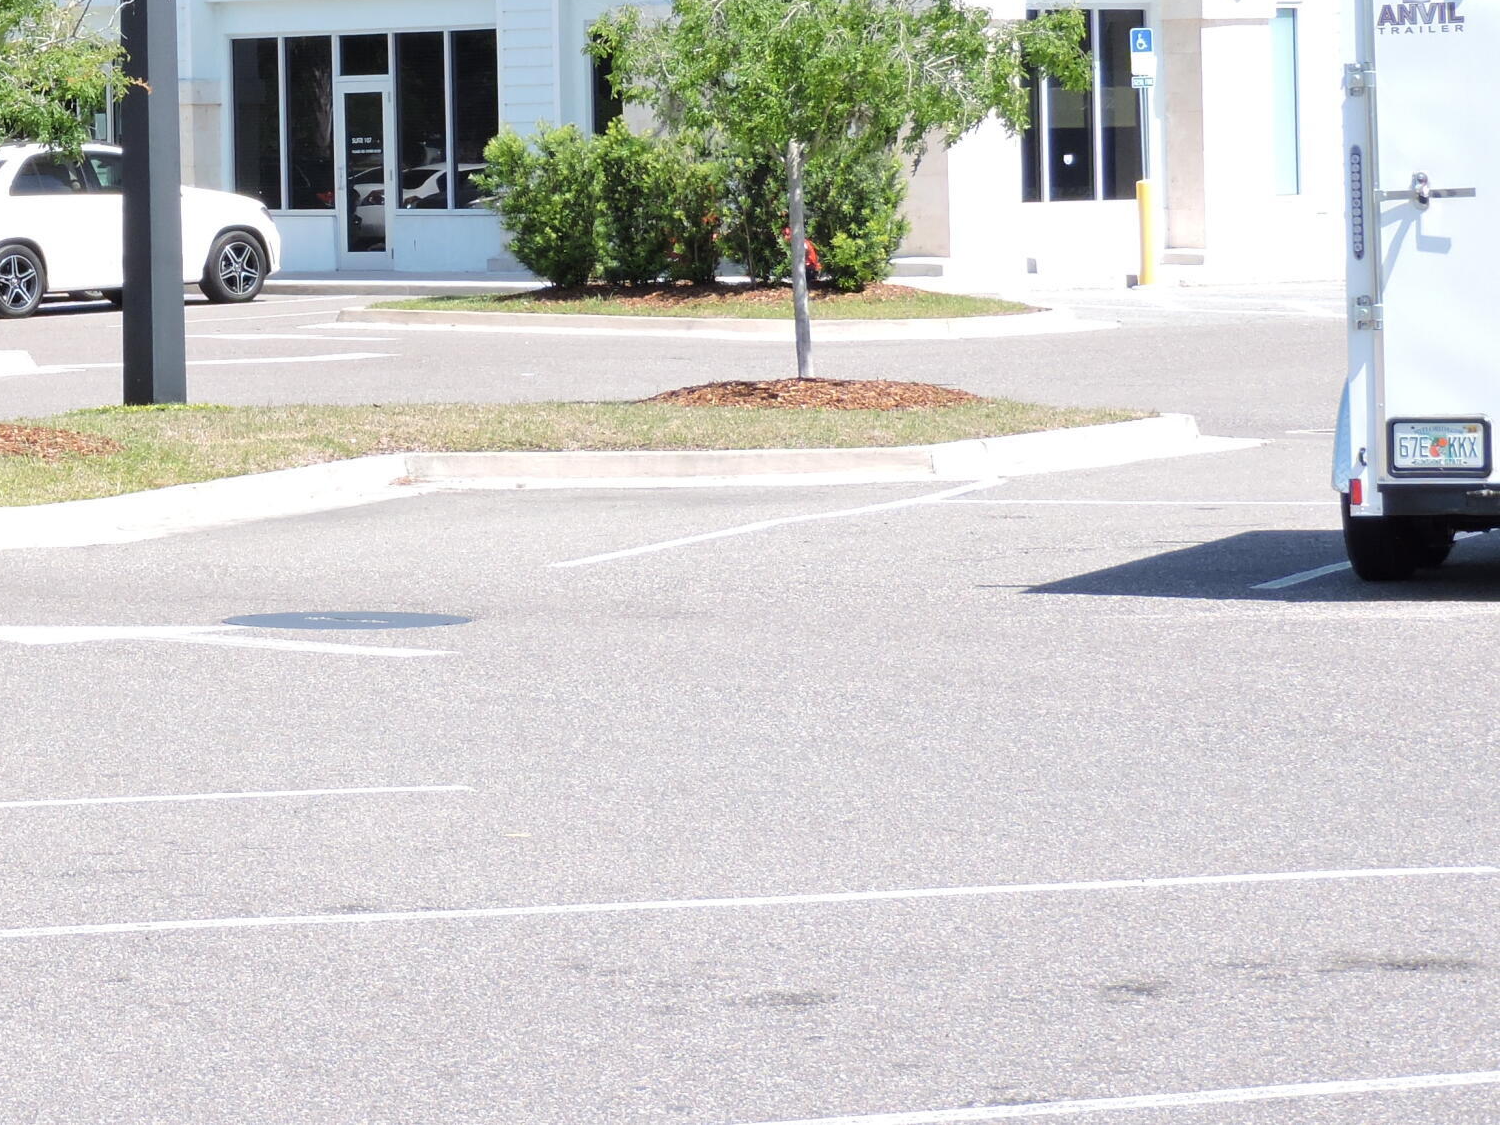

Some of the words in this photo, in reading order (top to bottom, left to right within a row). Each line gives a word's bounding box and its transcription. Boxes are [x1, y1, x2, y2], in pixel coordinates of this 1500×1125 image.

[1377, 2, 1465, 26] ANVIL
[1378, 24, 1464, 35] TRAILER
[1399, 436, 1429, 458] 67E
[1448, 436, 1477, 458] KKX
